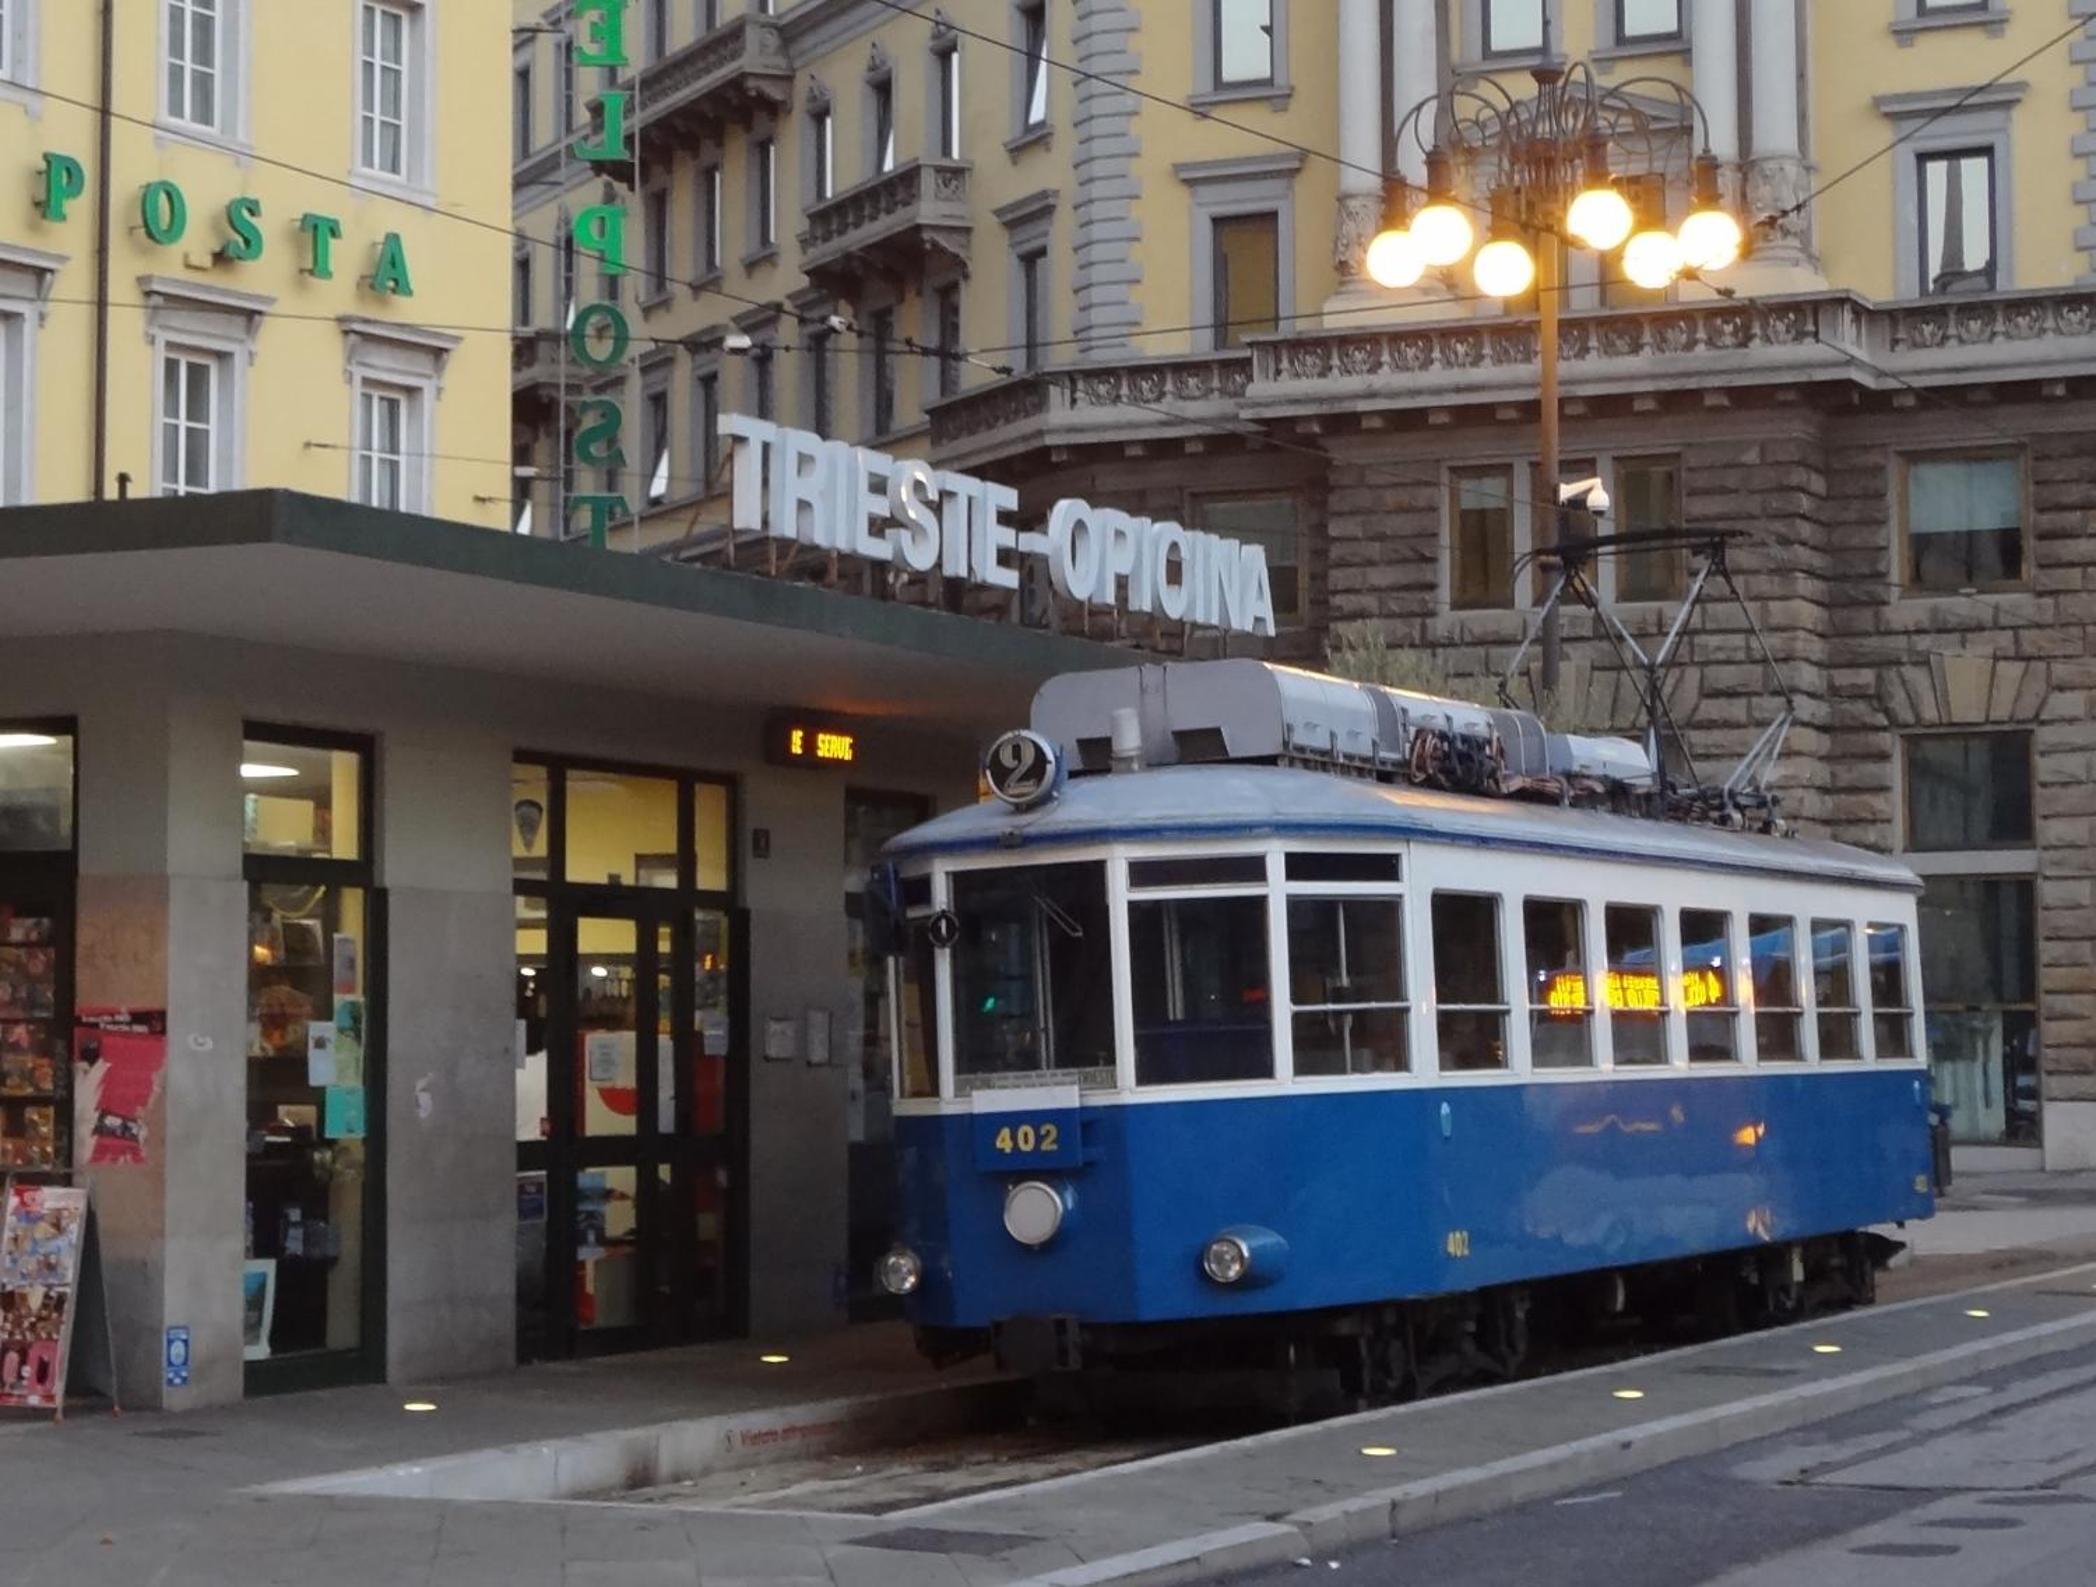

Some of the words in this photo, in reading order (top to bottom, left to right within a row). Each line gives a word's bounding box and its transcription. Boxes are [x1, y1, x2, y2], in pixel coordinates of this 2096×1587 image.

[42, 151, 414, 298] POSTA
[718, 412, 1276, 637] TRIESTE-OPICINA
[999, 737, 1037, 796] 2
[995, 1122, 1058, 1153] 402
